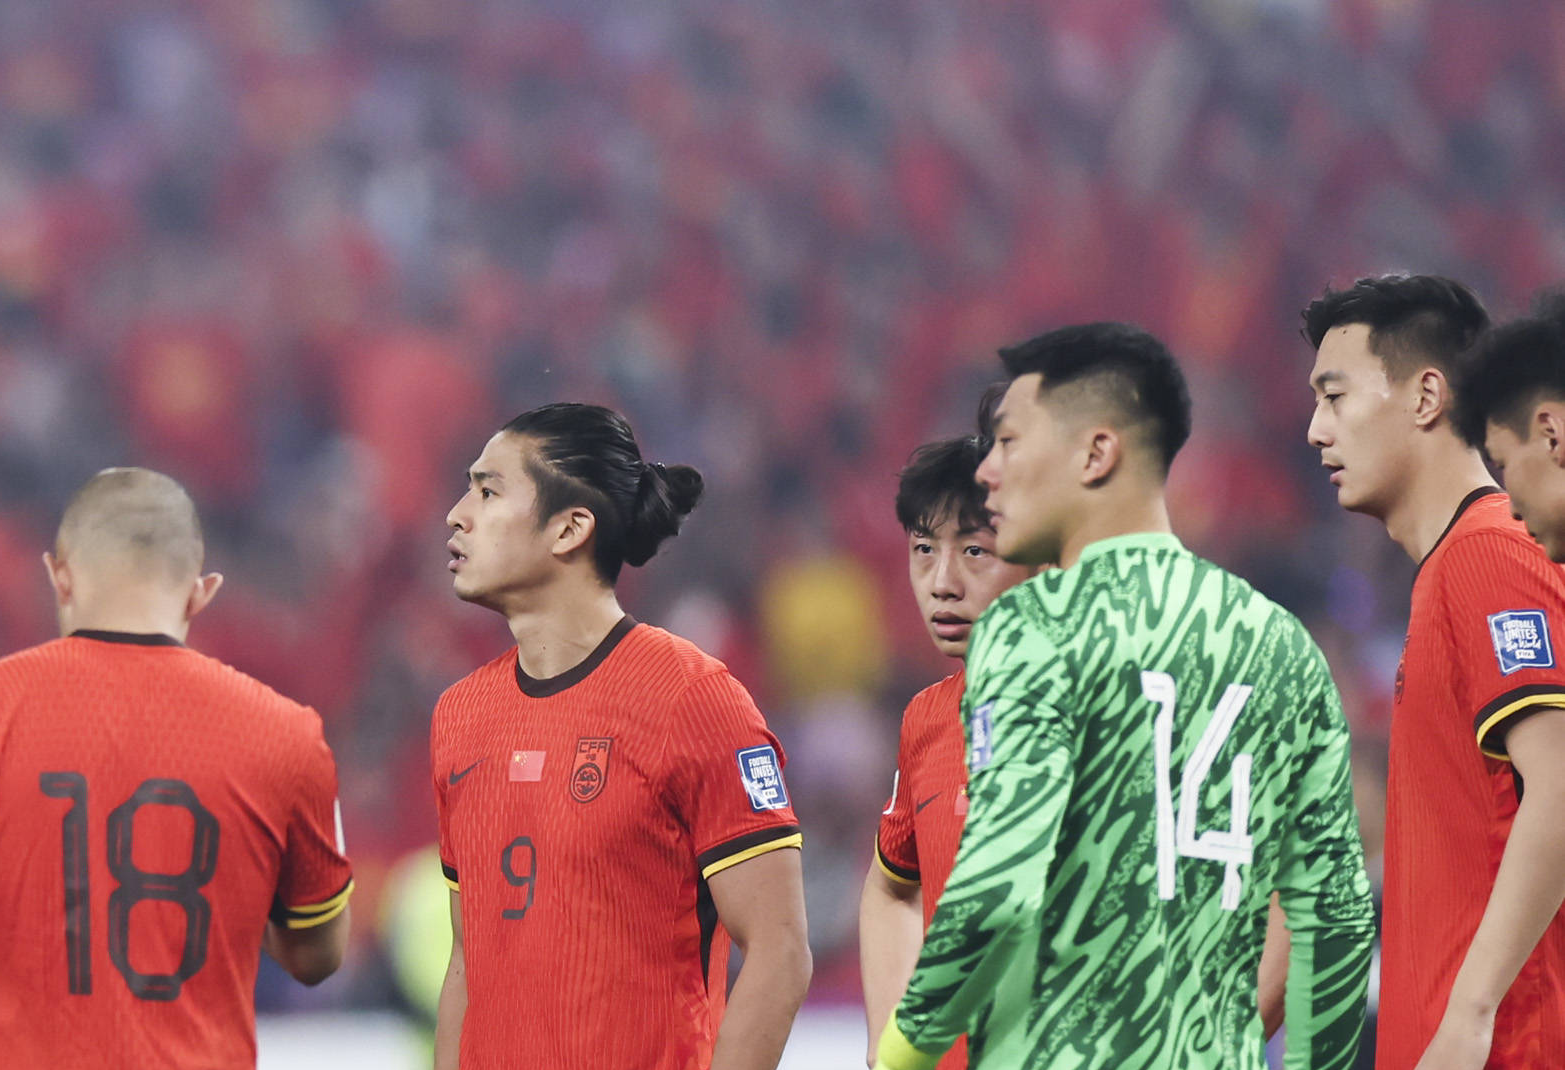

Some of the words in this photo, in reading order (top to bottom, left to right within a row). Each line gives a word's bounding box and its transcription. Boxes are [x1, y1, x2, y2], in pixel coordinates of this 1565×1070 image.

[1505, 628, 1538, 641] UNITES
[579, 741, 608, 753] CFA
[1141, 670, 1253, 910] 14
[39, 772, 221, 1000] 18
[501, 836, 537, 919] 9
